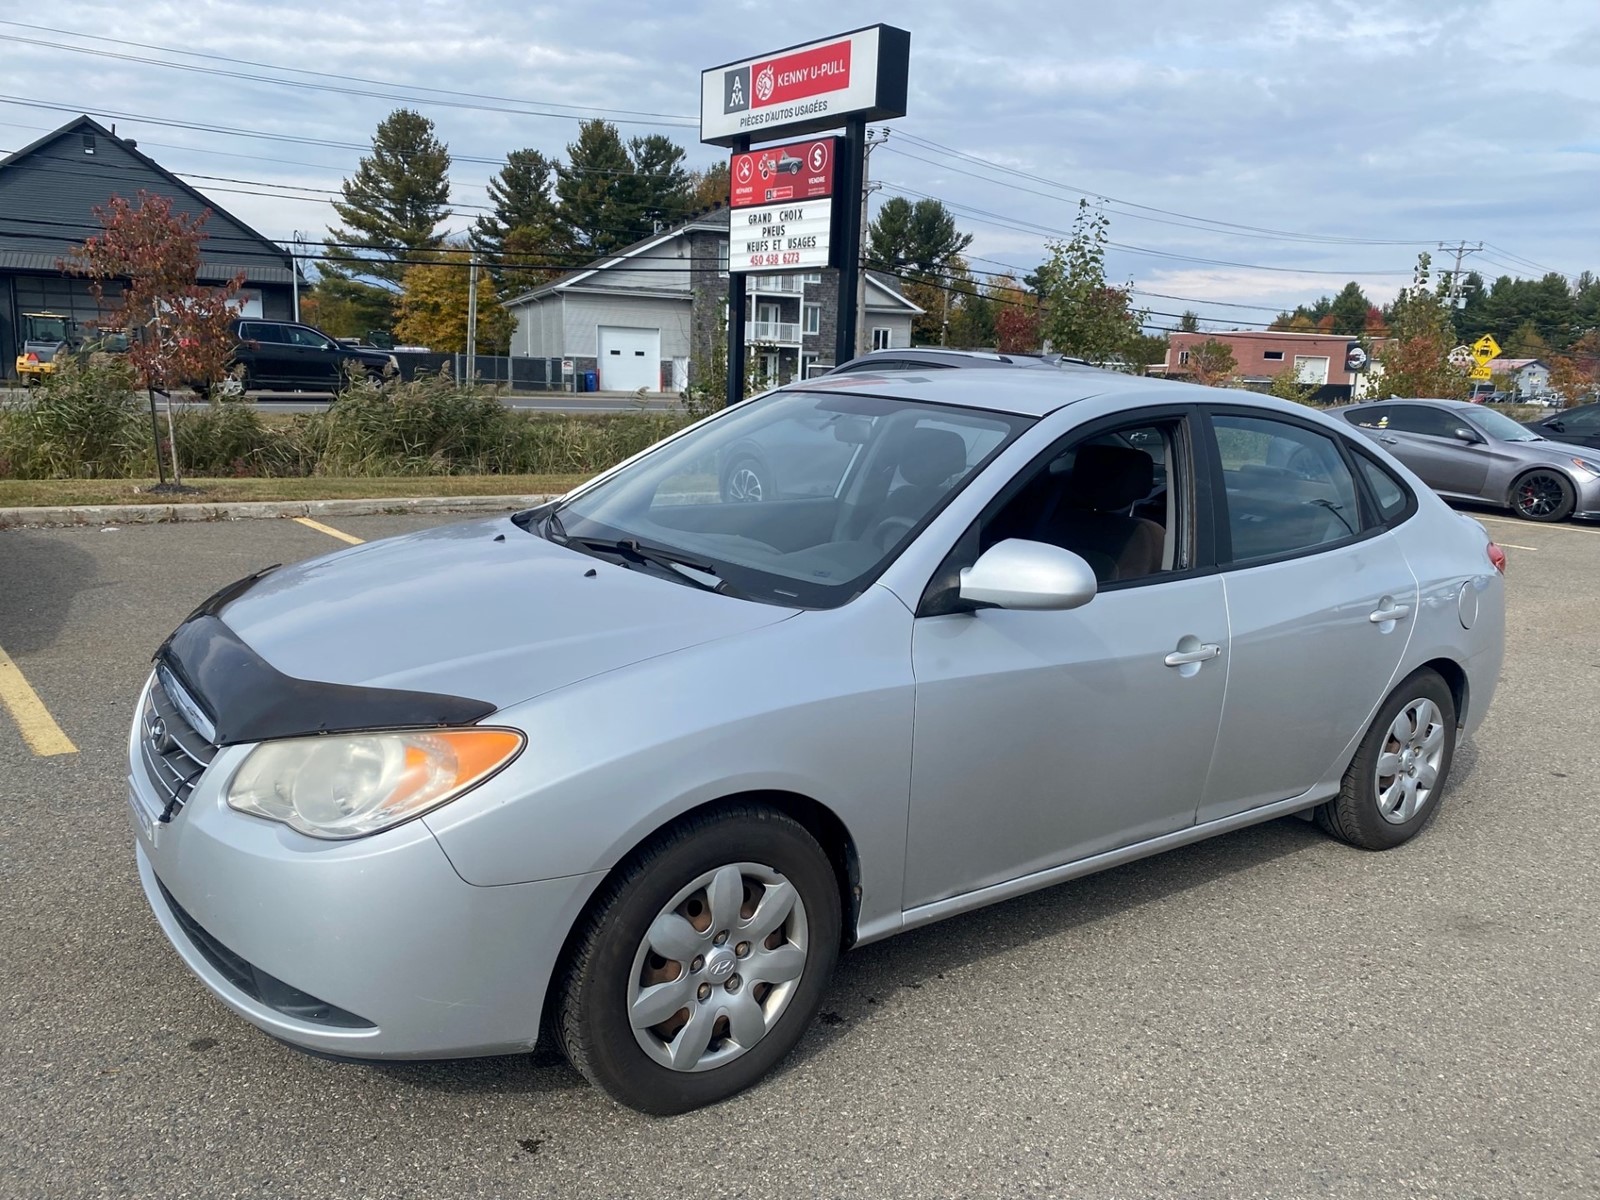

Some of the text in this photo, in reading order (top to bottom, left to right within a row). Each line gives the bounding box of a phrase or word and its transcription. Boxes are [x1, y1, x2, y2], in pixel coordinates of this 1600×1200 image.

[777, 59, 845, 87] KENNY U-PULL
[740, 100, 828, 127] PIÈCES D'AUTOS USAGÉES
[748, 208, 803, 225] GRAND CHOIX
[762, 225, 785, 237] PNEUS
[747, 236, 816, 253] NEUFS ET USAGES
[750, 252, 800, 266] 450 438 6273
